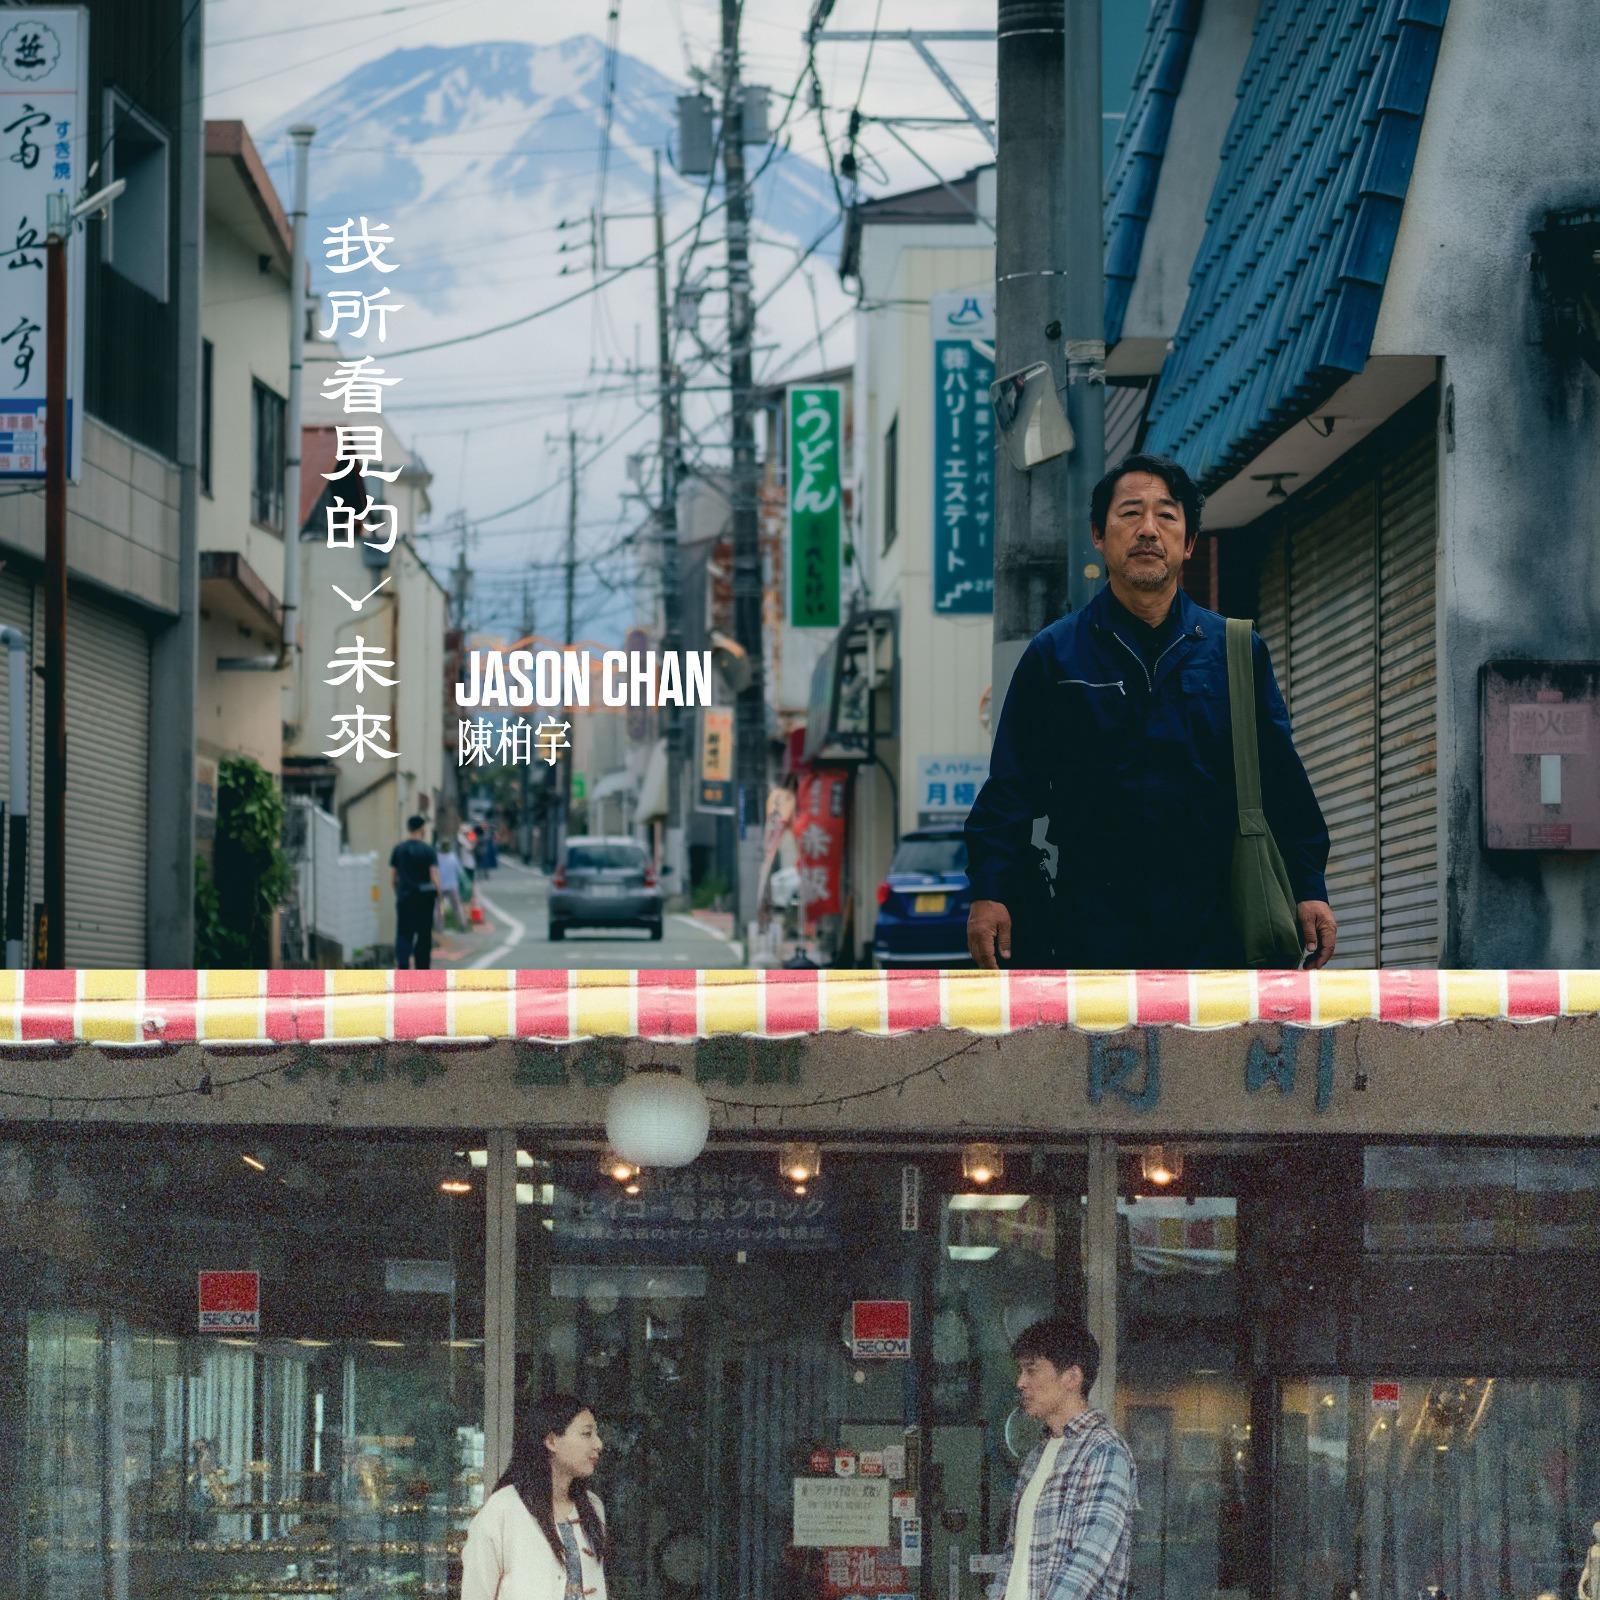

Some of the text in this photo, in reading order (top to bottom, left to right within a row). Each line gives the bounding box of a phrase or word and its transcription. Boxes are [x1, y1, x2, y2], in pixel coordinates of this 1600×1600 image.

[794, 394, 836, 514] うどん
[203, 1313, 256, 1325] SECOM
[856, 1340, 907, 1353] SECOM
